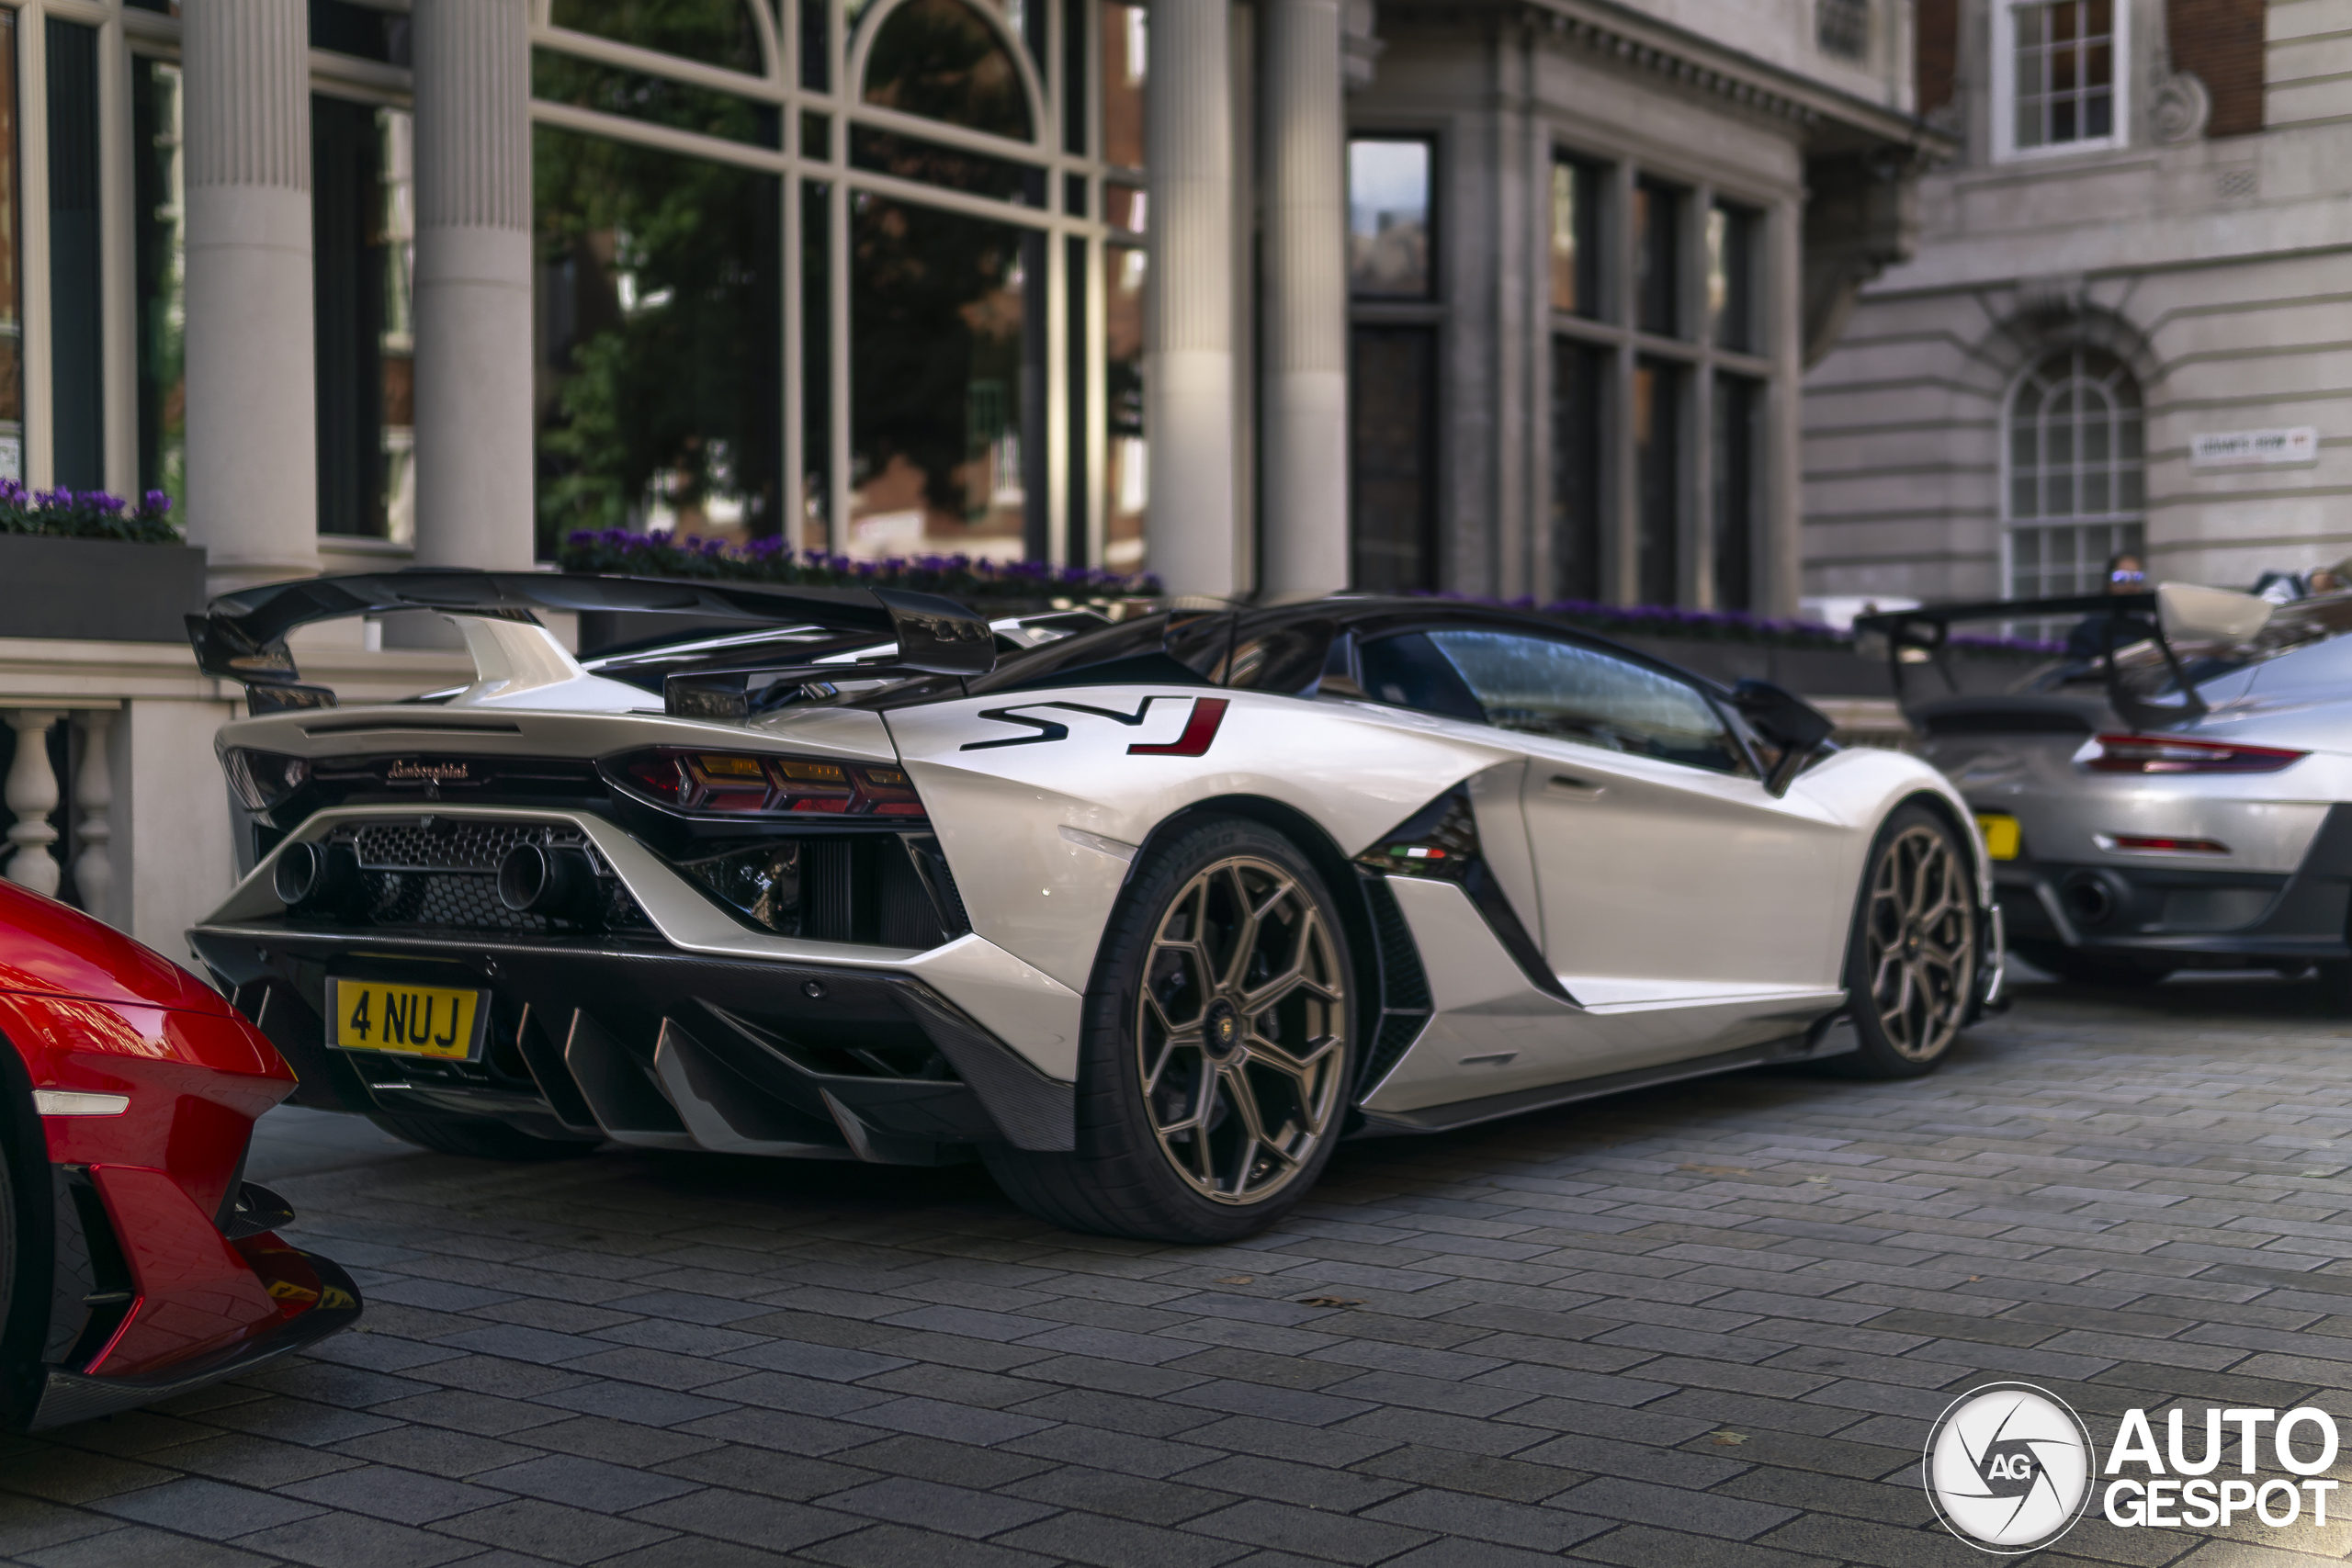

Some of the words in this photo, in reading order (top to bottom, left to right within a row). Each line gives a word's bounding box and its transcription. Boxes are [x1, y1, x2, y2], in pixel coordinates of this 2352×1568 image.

[959, 695, 1230, 757] SVJ
[388, 760, 469, 786] Lamborghini
[350, 989, 371, 1041] 4
[383, 991, 459, 1049] NUJ
